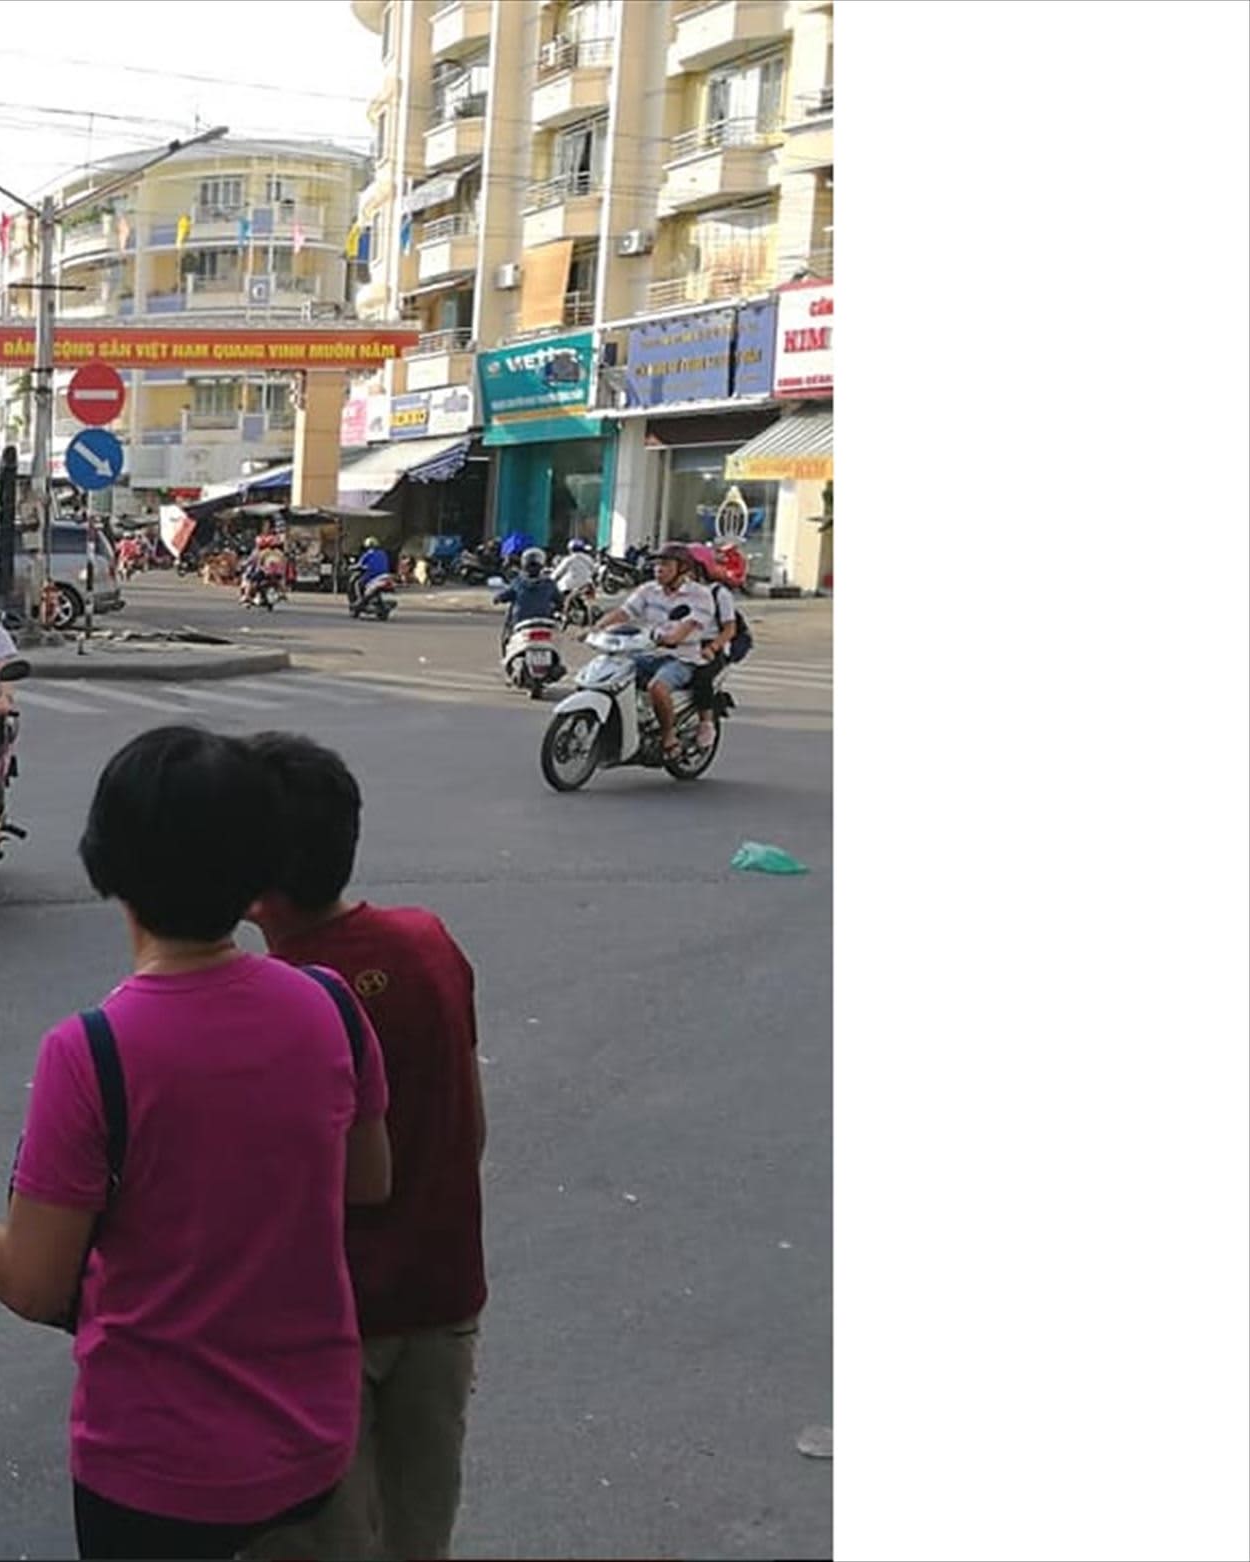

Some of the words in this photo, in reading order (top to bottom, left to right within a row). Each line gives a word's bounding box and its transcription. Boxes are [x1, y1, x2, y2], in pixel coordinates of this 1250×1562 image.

[3, 337, 37, 357] ĐẢN
[136, 341, 168, 359] VIỆT
[172, 343, 208, 358] NAM
[213, 343, 264, 360] QUANG
[269, 343, 305, 358] VINH
[784, 326, 833, 353] KIM
